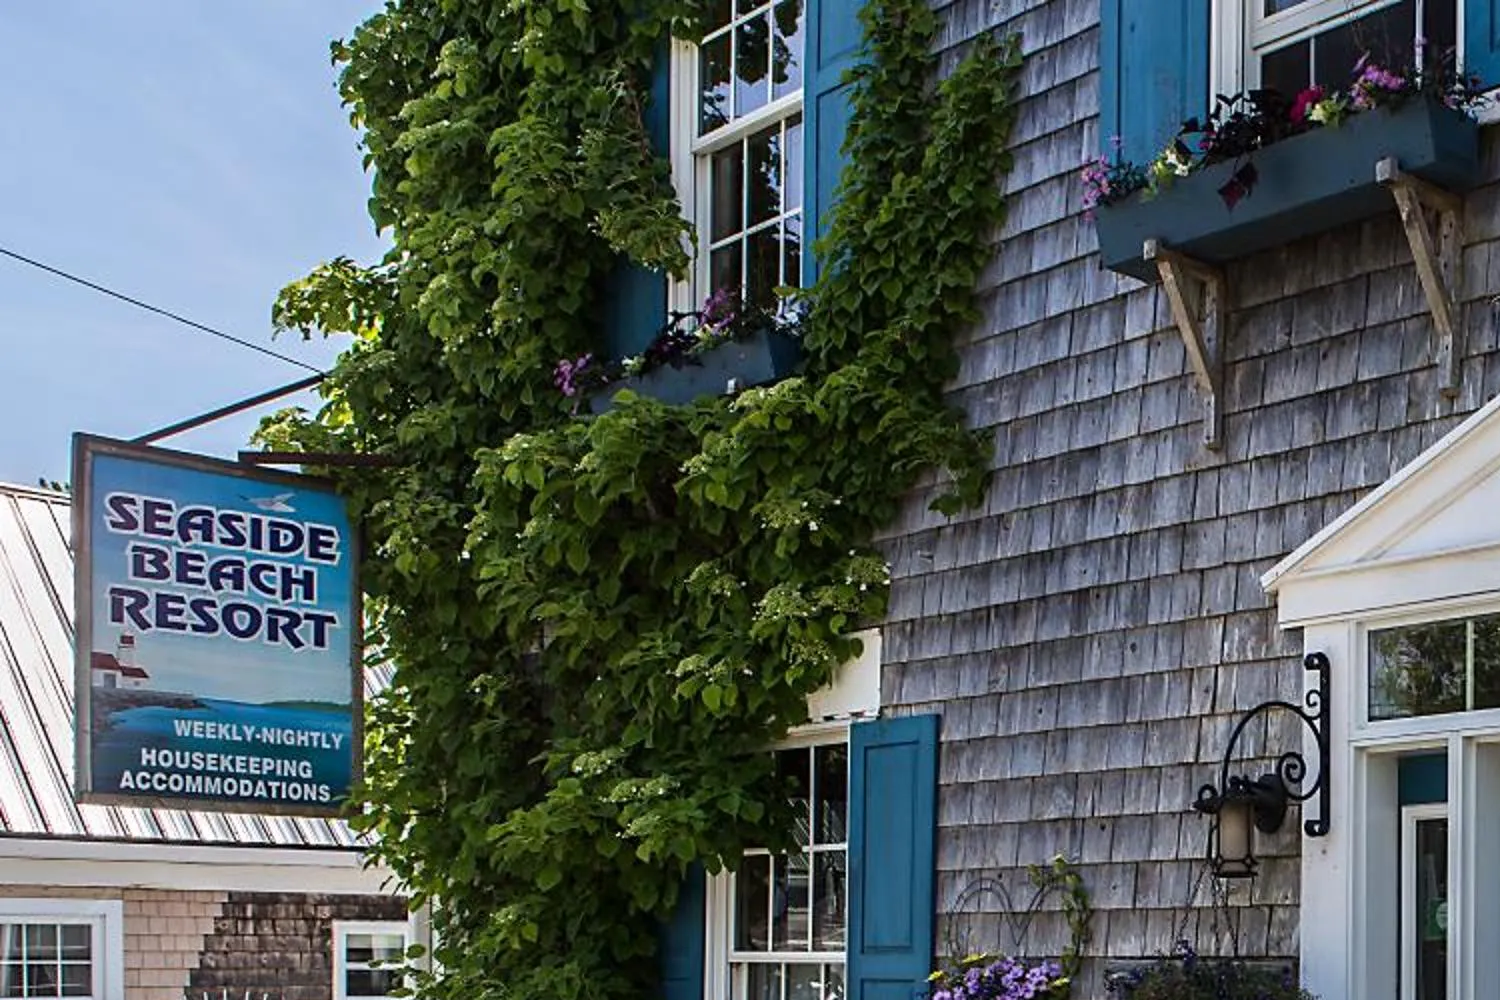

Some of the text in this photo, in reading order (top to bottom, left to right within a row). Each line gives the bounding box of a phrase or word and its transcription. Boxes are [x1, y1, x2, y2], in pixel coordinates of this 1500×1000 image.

[106, 493, 341, 562] SEASIDE
[130, 544, 316, 602] BEACH
[108, 587, 337, 650] RESORT
[173, 718, 343, 750] WEEKLY-NIGHTLY
[119, 770, 332, 801] ACCOMMODATIONS
[140, 747, 313, 779] HOUSEKEEPING
